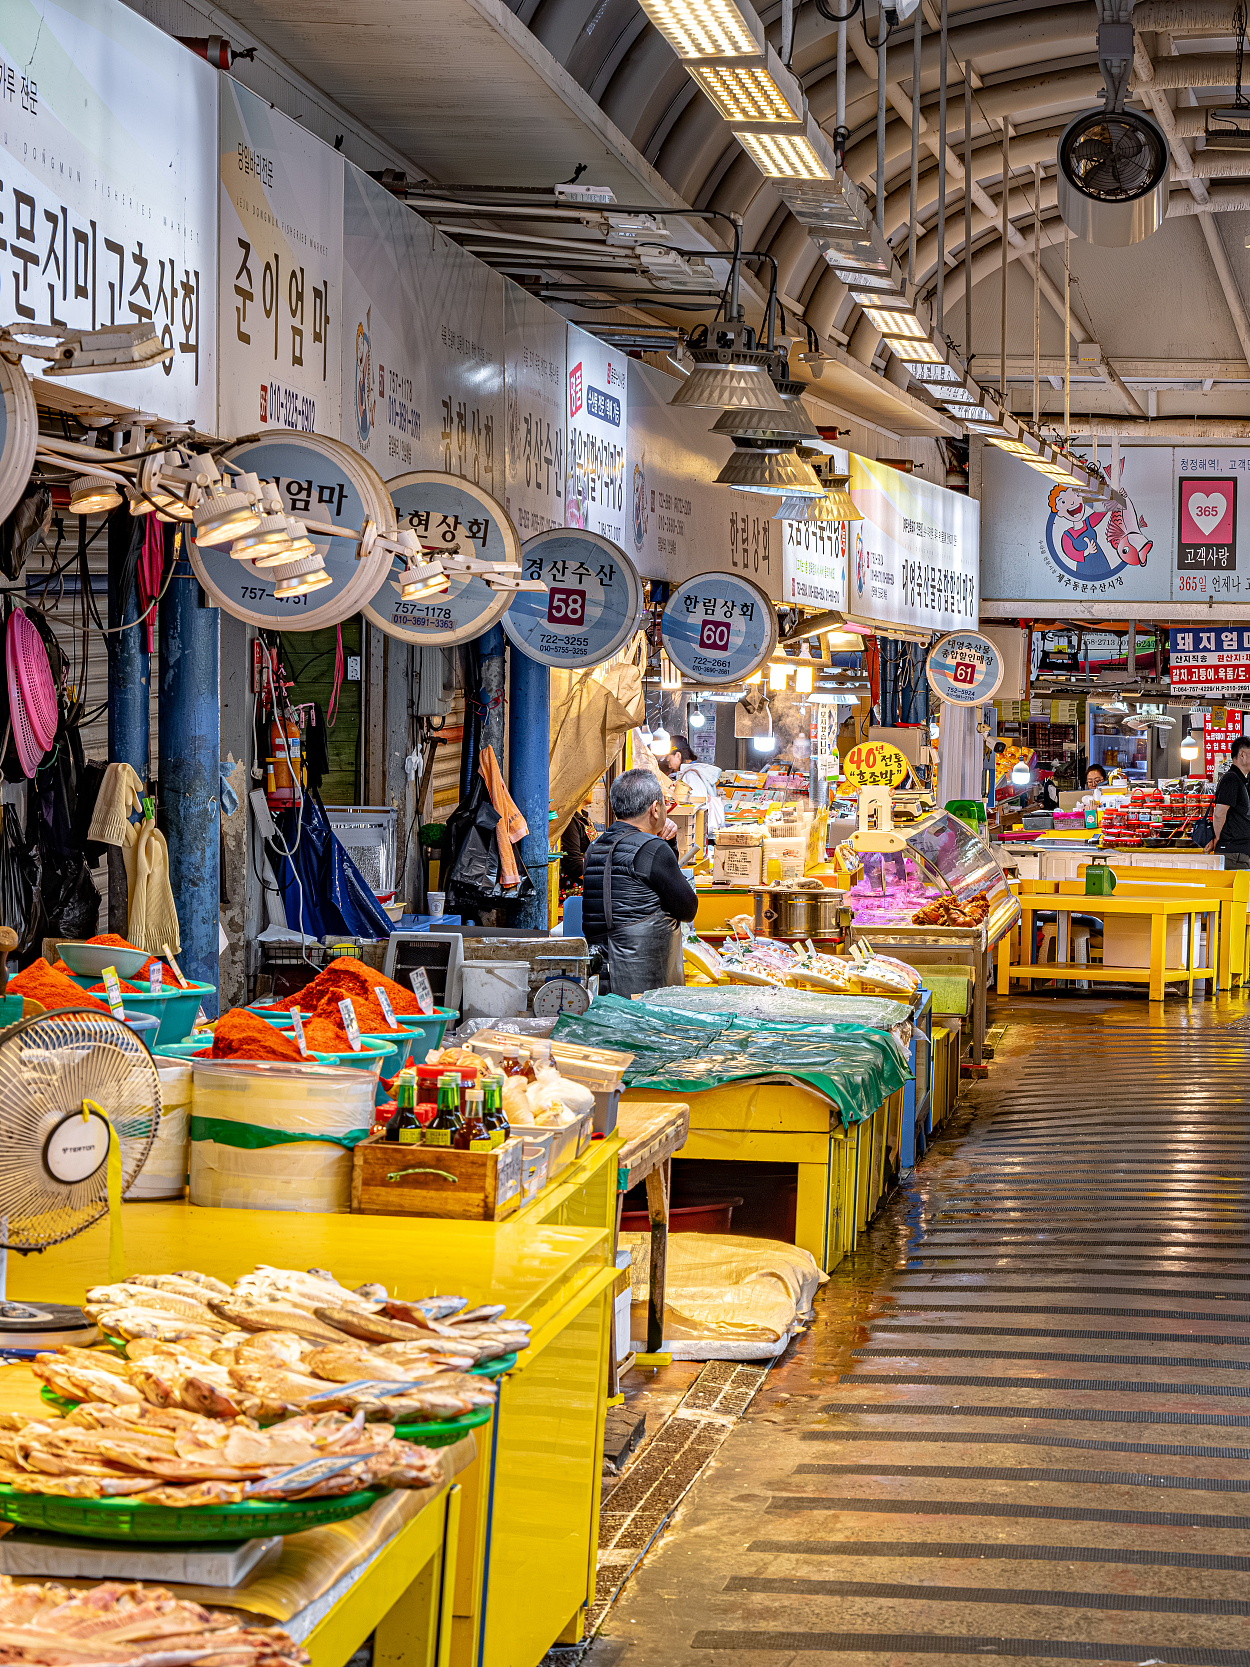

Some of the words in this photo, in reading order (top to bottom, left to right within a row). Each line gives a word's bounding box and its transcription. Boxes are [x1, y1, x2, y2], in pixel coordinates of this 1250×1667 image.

[20, 75, 38, 116] 전문
[0, 178, 199, 386] 문진미고추상회
[234, 236, 330, 381] 준이엄마
[523, 413, 562, 498] 경산수산
[1180, 458, 1223, 472] 청정해역!,
[1195, 505, 1219, 518] 365
[395, 504, 491, 548] 현상회
[730, 511, 771, 575] 한림상회
[1184, 546, 1230, 567] 고객사랑
[523, 556, 617, 588] 경산수산
[1056, 572, 1125, 594] 제주동문수산시장
[1179, 575, 1207, 593] 365일
[1211, 575, 1242, 593] 언제나
[394, 603, 452, 619] 757-1178
[551, 594, 582, 619] 58
[683, 594, 755, 622] 한림상회
[393, 615, 454, 630] 010-3691-3363
[540, 633, 589, 648] 722-3255
[703, 624, 728, 646] 60
[539, 644, 588, 656] 010-5755-3255
[941, 648, 994, 666] 종합할인매장
[948, 640, 990, 655] 대영축산물
[693, 656, 731, 669] 722-2661
[1174, 654, 1208, 664] 산지직송
[956, 665, 972, 681] 61
[849, 745, 885, 771] 40년
[880, 753, 904, 769] 전통
